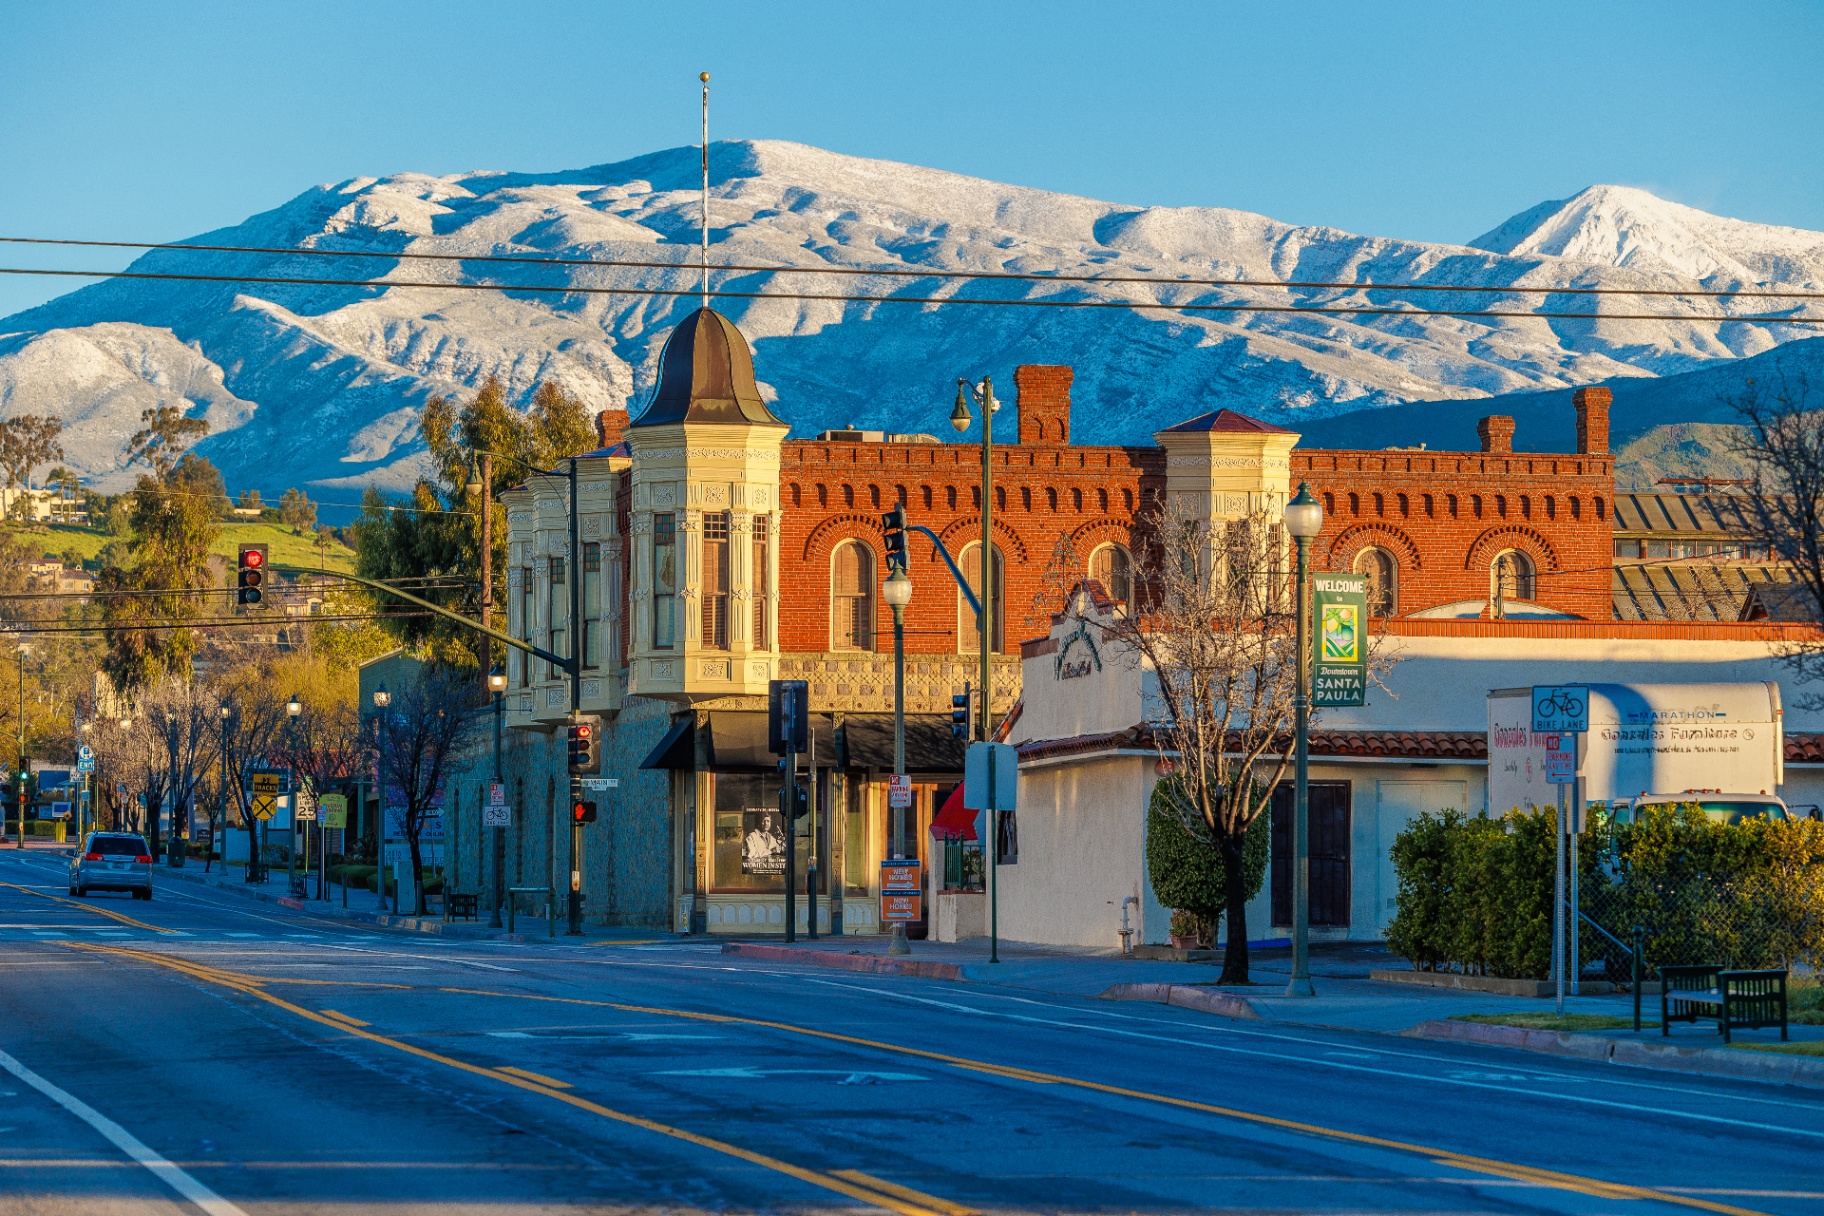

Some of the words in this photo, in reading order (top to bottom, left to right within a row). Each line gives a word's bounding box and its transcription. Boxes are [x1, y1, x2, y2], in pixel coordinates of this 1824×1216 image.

[1315, 579, 1364, 593] WELCOME
[1320, 666, 1359, 676] Downtown
[1317, 678, 1361, 689] SANTA
[1317, 691, 1360, 701] PAULA
[1639, 711, 1715, 719] MARATHON
[1537, 720, 1556, 730] BIKE
[1561, 720, 1584, 730] LANE
[1494, 722, 1527, 749] Gonzales
[1601, 727, 1664, 740] Gonzales
[1670, 727, 1738, 740] Furniture
[1548, 738, 1559, 750] NO
[1548, 752, 1572, 761] PARKING
[298, 806, 315, 817] 25
